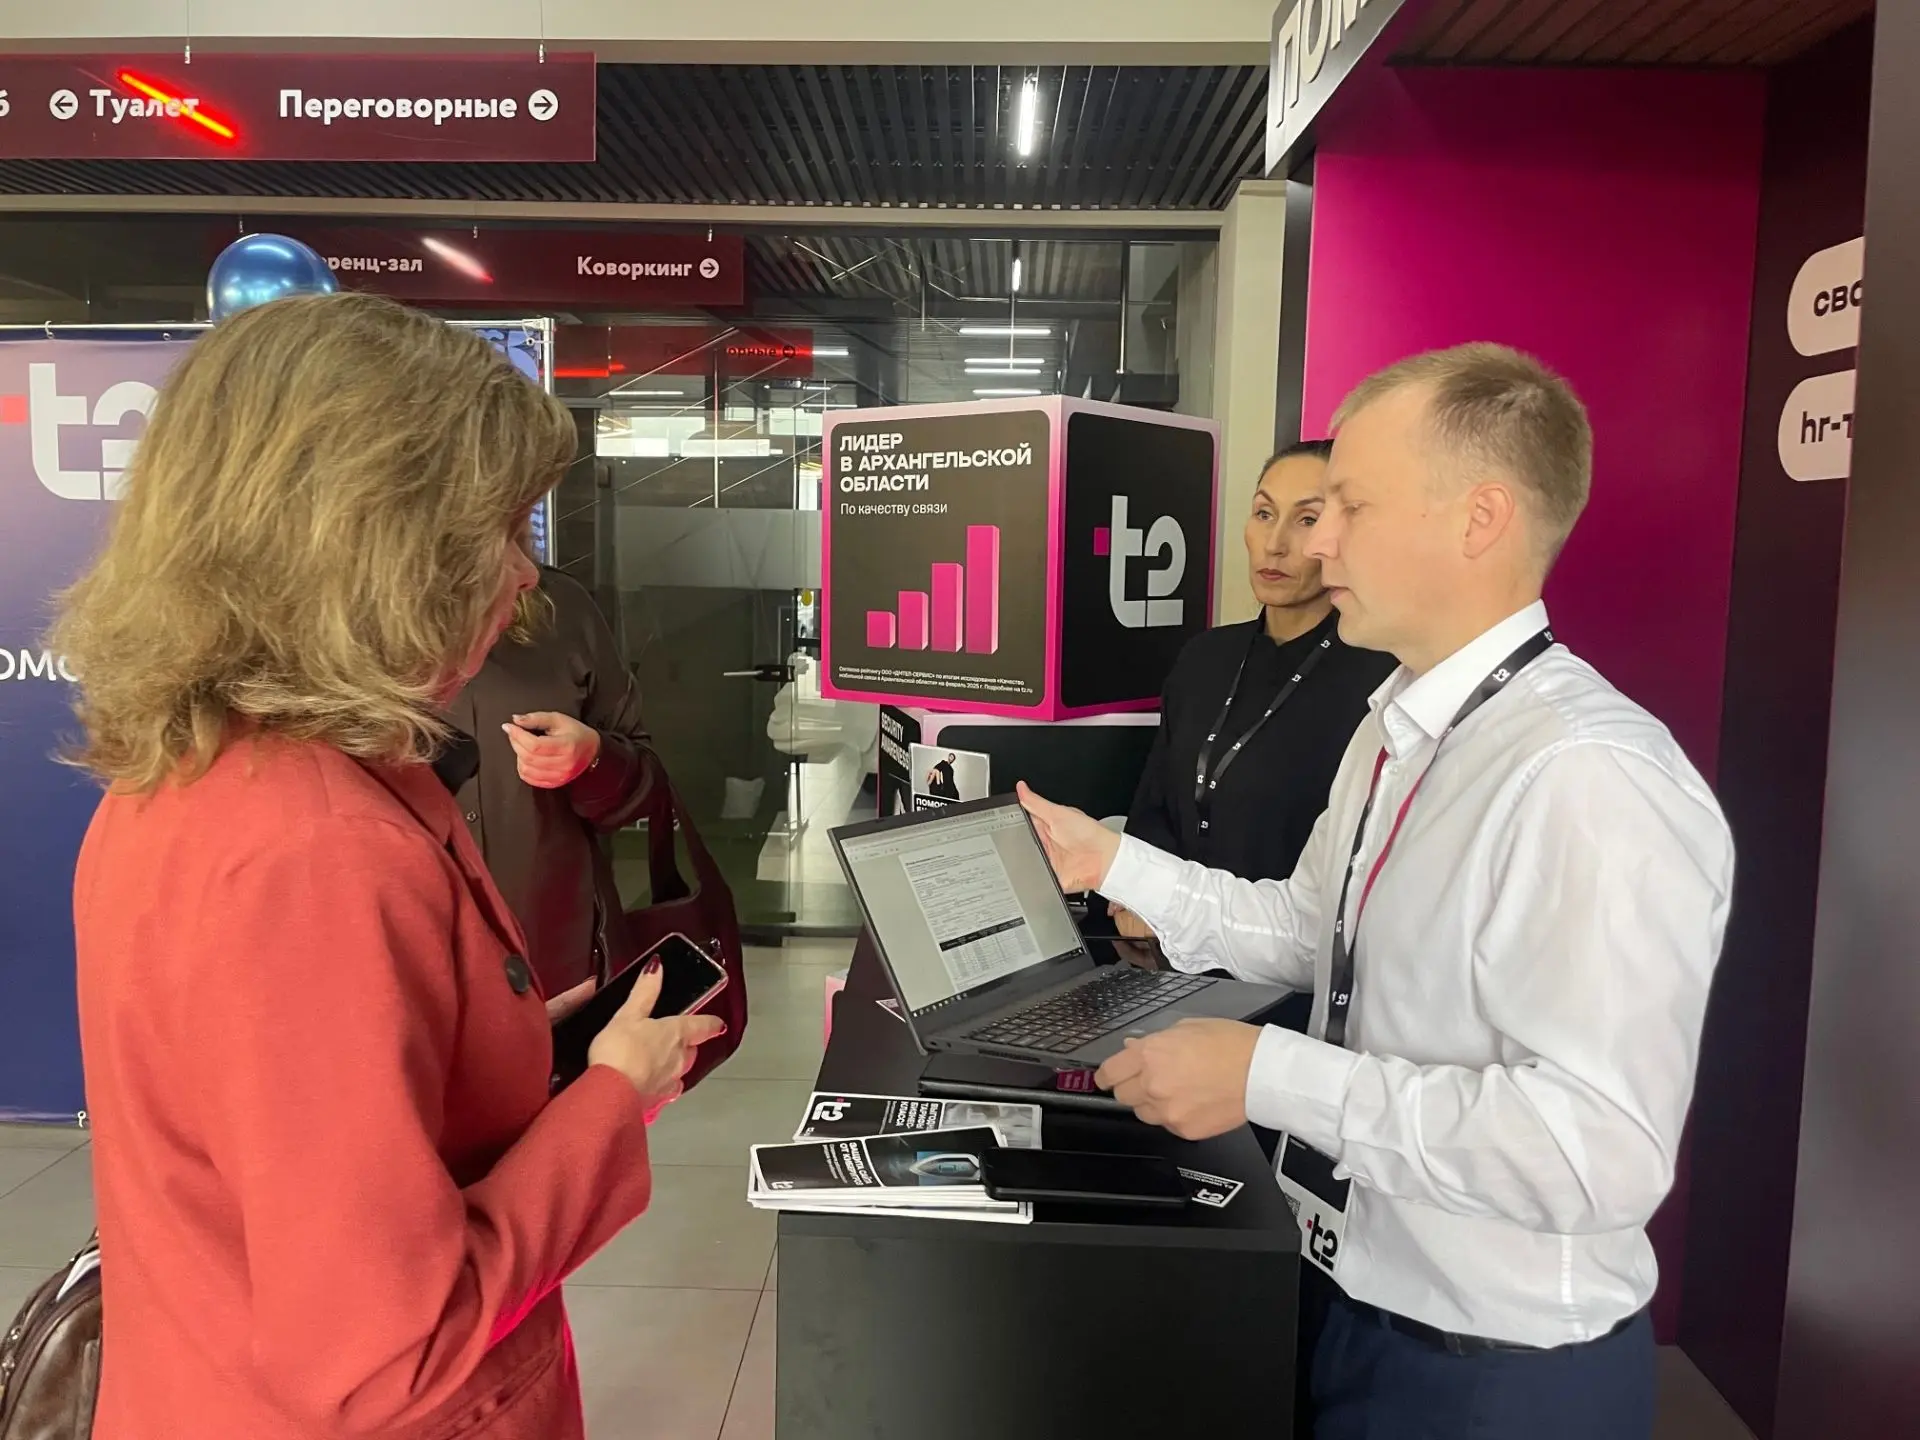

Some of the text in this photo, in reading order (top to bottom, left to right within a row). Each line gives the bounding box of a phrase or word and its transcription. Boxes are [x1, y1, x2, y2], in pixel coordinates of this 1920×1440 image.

[89, 89, 200, 124] Туалет
[279, 89, 518, 126] Переговорные
[322, 256, 423, 273] ренц-зал
[577, 256, 693, 281] Коворкинг
[840, 433, 904, 453] ЛИДЕР
[840, 442, 1032, 472] В АРХАНГЕЛЬСКОЙ
[840, 474, 930, 493] ОБЛАСТИ
[840, 502, 948, 517] По качеству связи
[1109, 495, 1187, 628] t2
